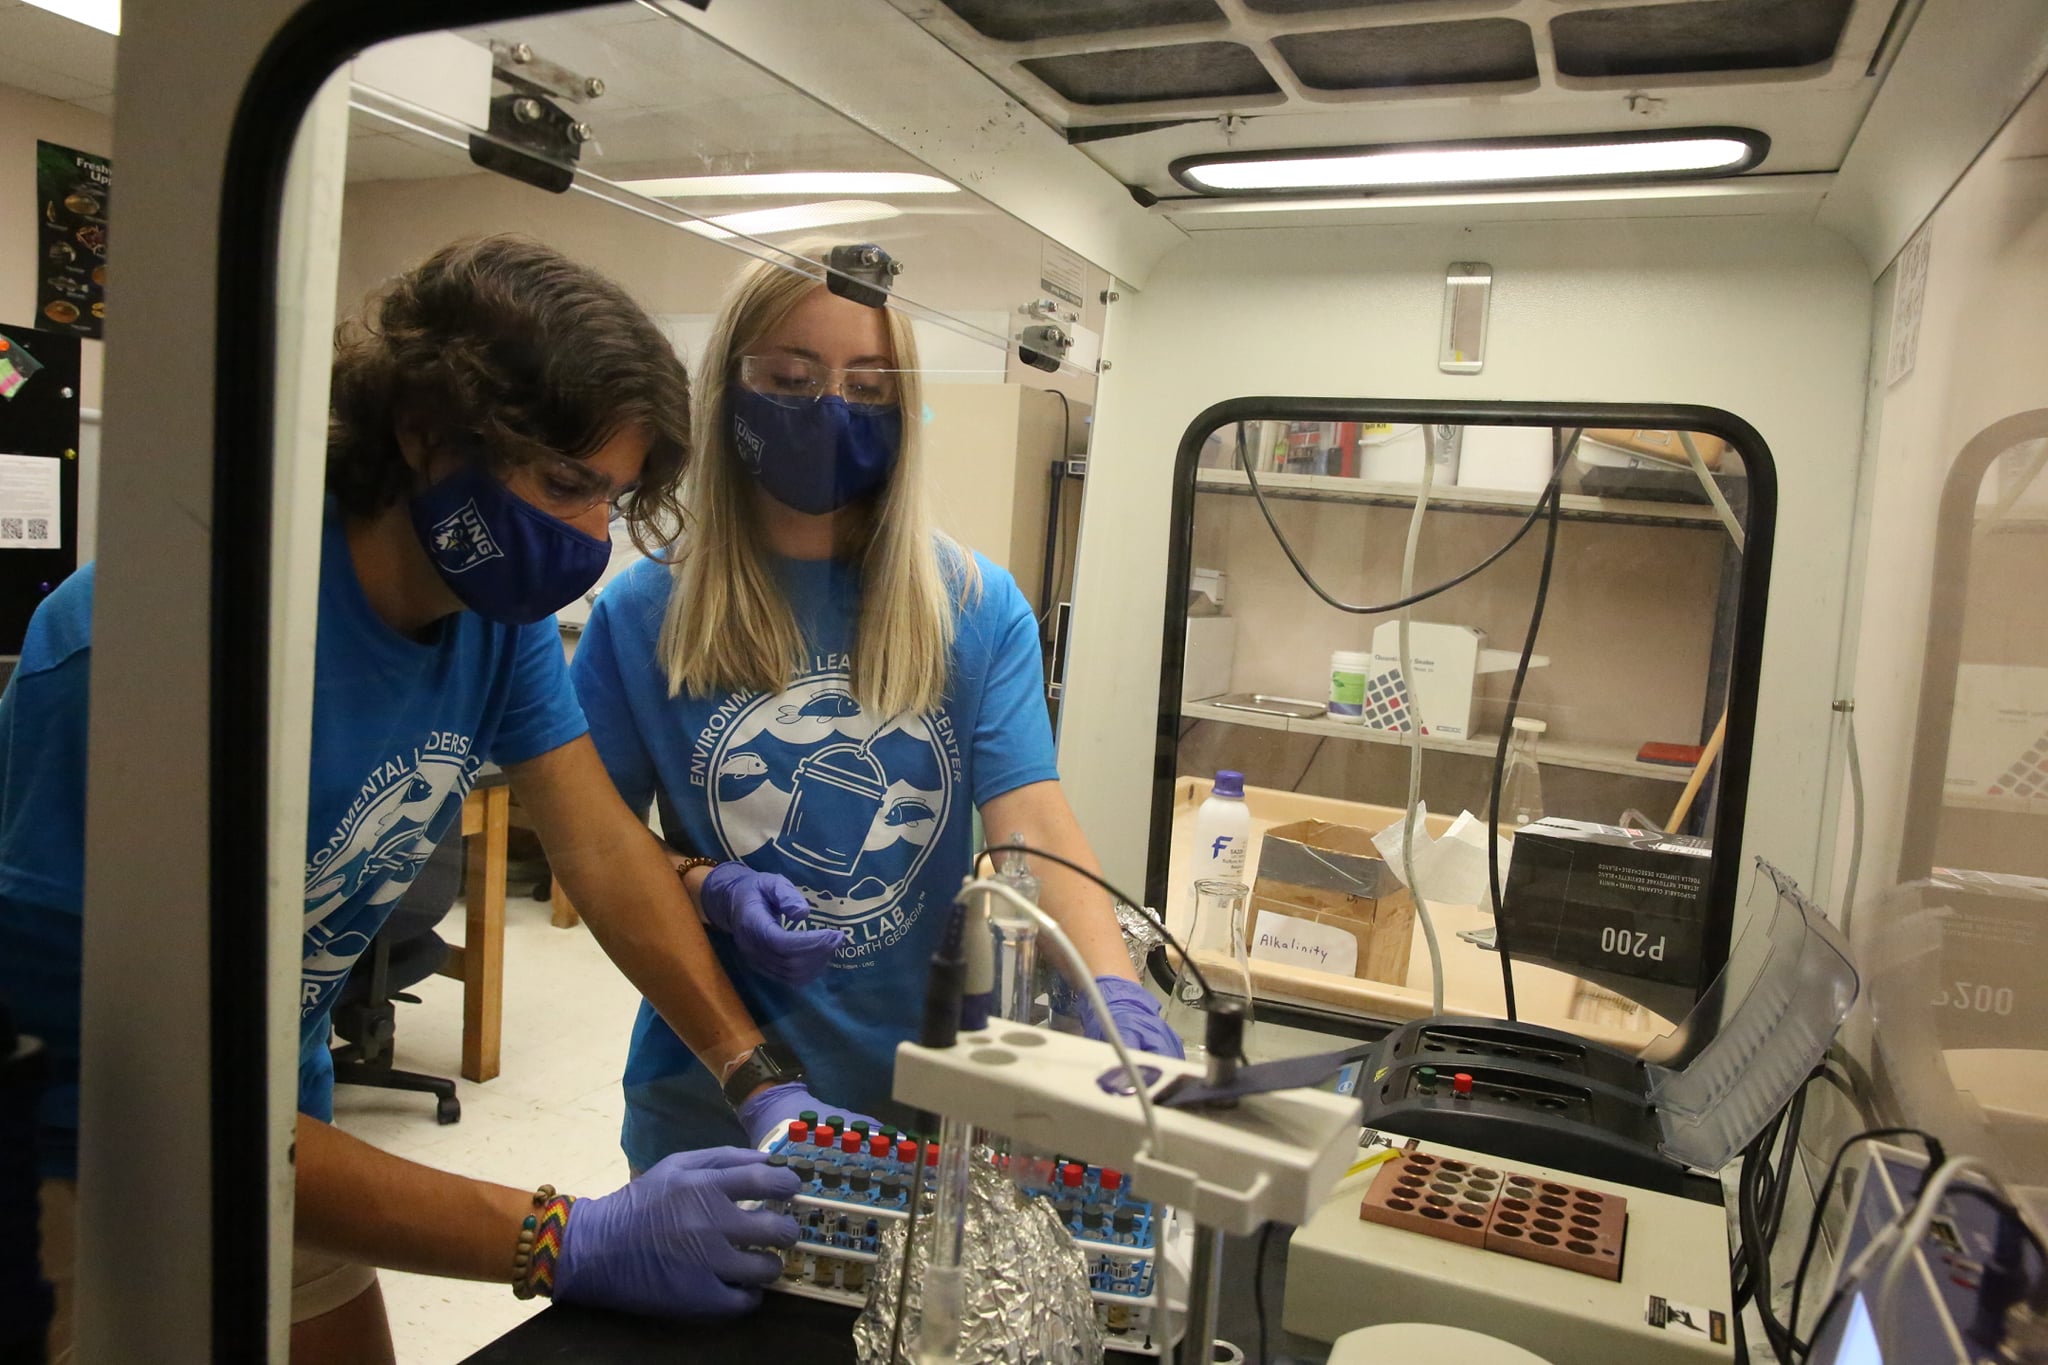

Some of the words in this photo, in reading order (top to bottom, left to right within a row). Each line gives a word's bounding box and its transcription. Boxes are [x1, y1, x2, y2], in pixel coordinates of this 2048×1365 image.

[736, 422, 760, 450] UNG
[462, 508, 493, 556] UNG
[863, 905, 905, 941] LAB
[834, 941, 882, 959] NORTH
[1259, 934, 1328, 964] Alkalinity
[1601, 927, 1666, 962] P200
